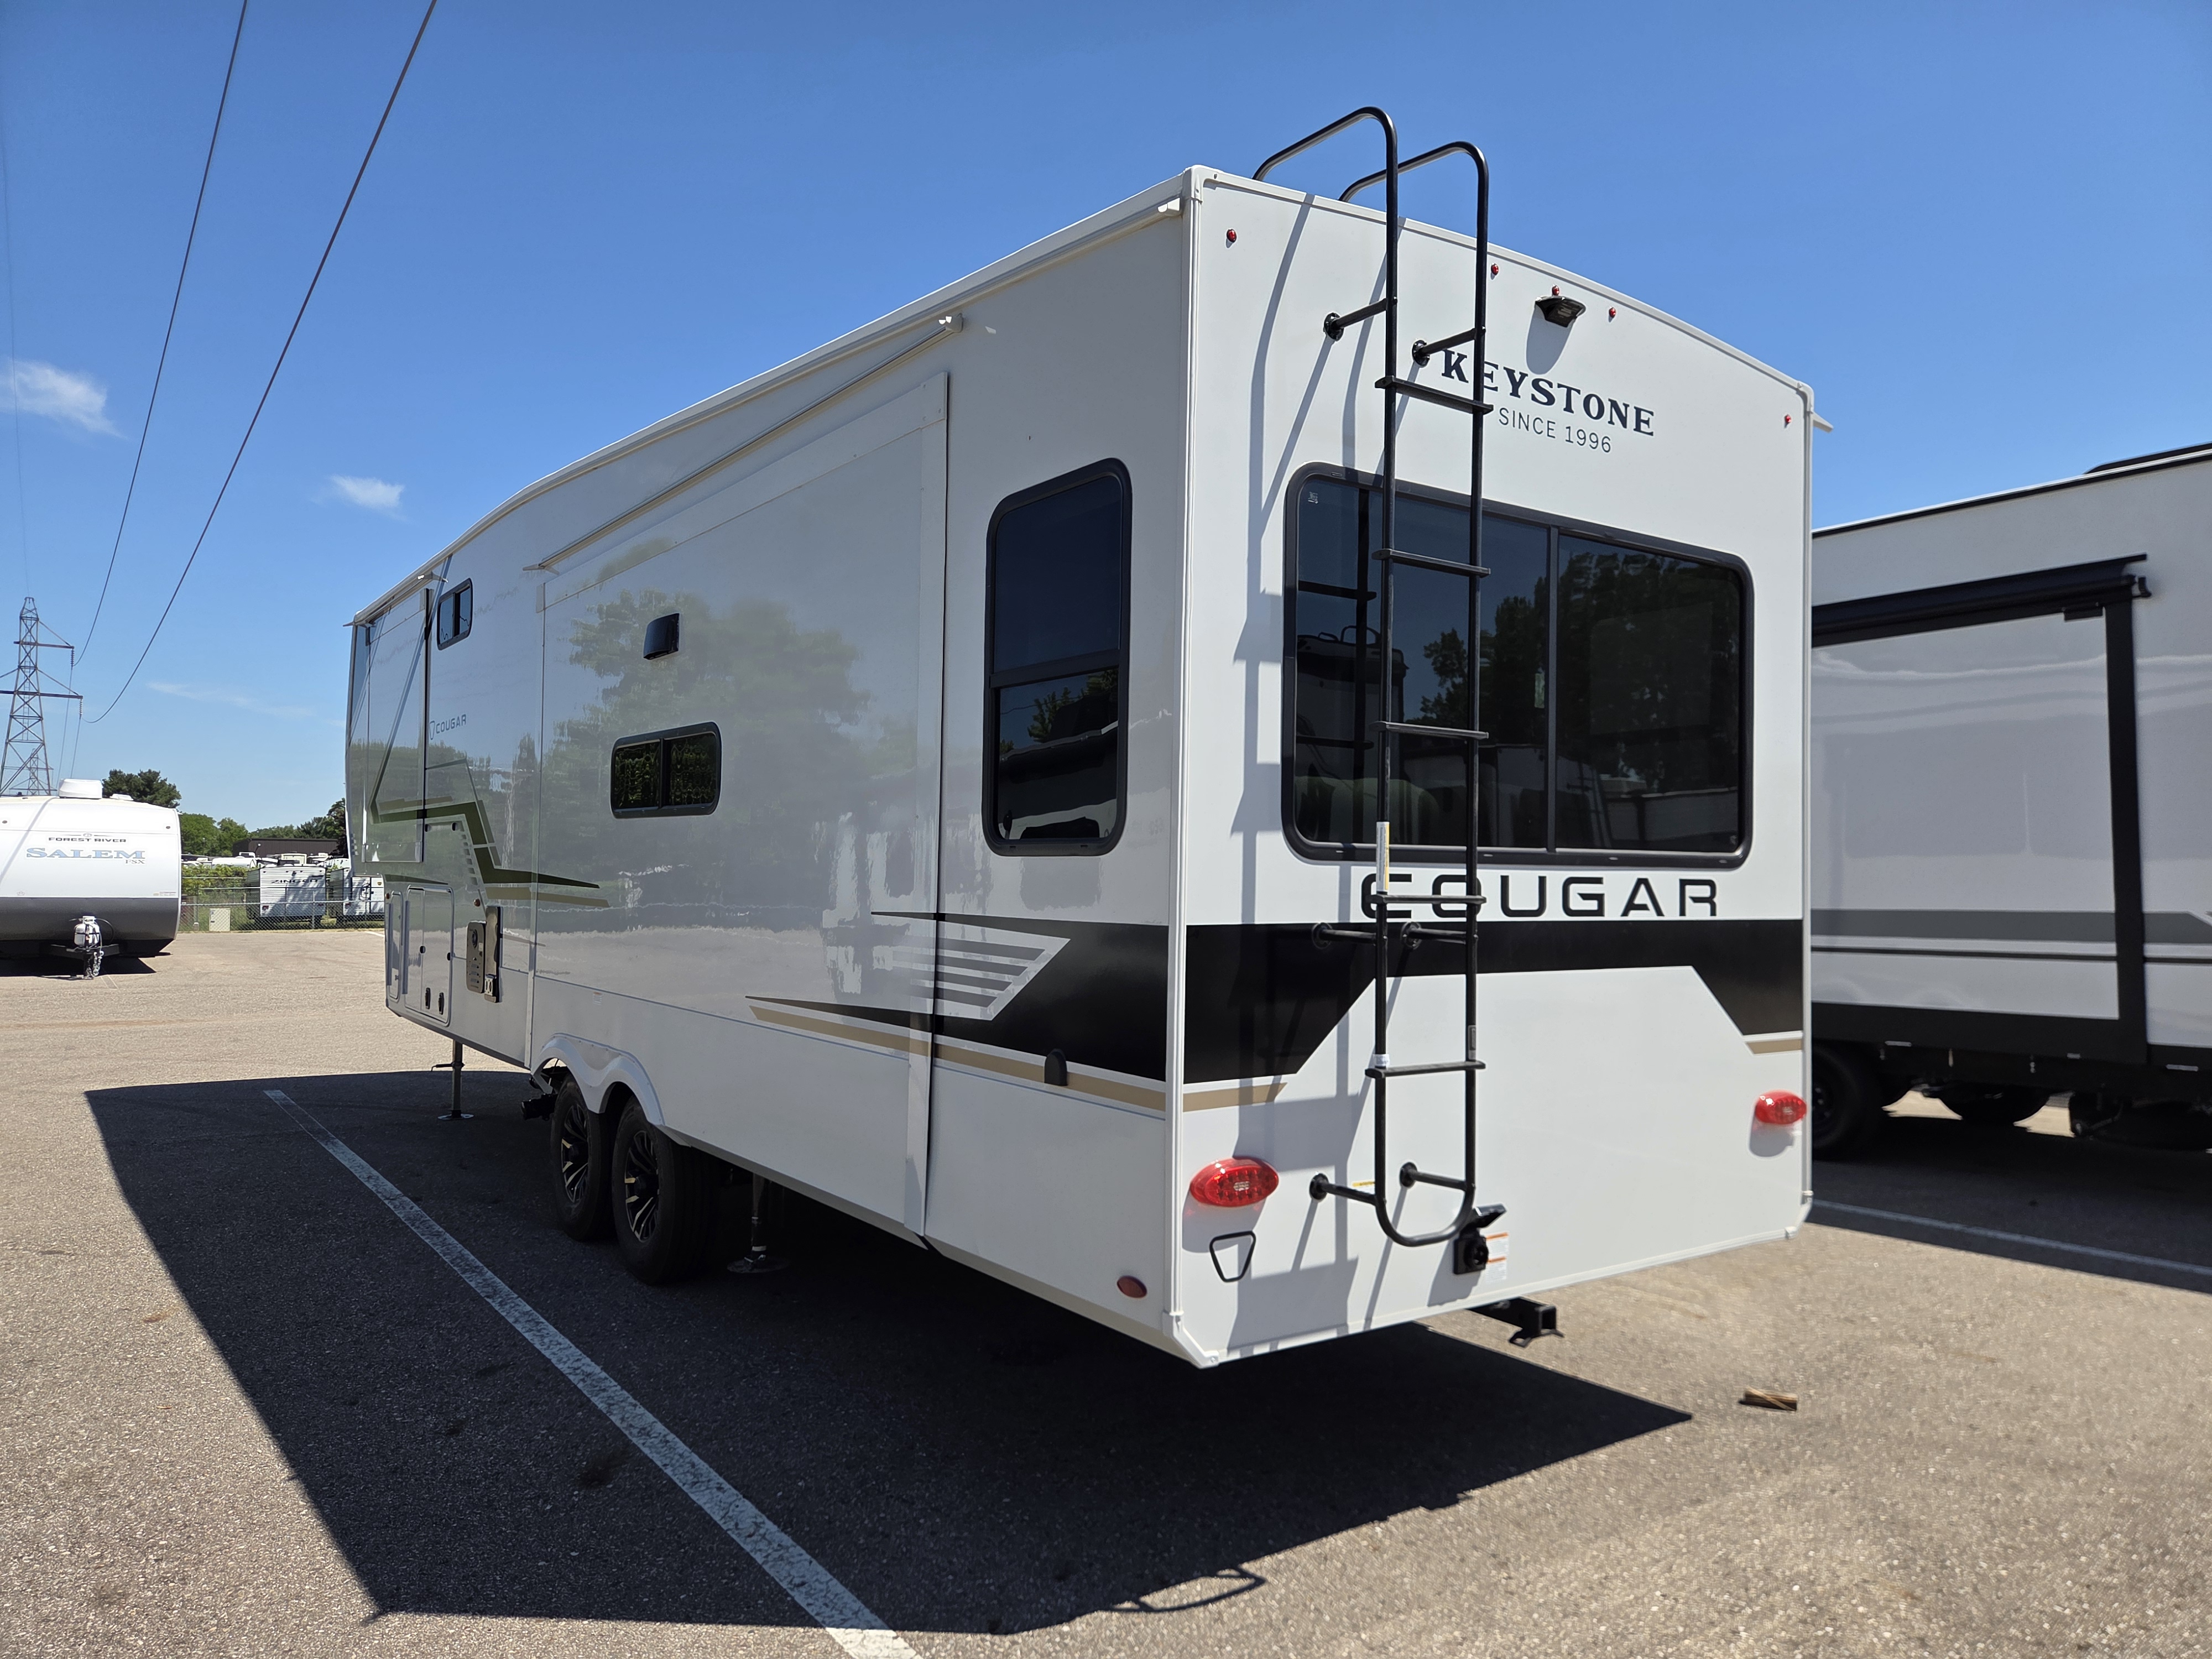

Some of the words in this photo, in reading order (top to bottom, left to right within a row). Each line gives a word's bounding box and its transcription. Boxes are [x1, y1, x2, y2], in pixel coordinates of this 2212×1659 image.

[1441, 348, 1655, 437] KEYSTONE
[1498, 407, 1556, 439] SINCE
[1564, 425, 1611, 453] 1996
[436, 714, 466, 734] COUGAR
[27, 848, 145, 859] SALEM
[1361, 873, 1717, 919] COUGAR
